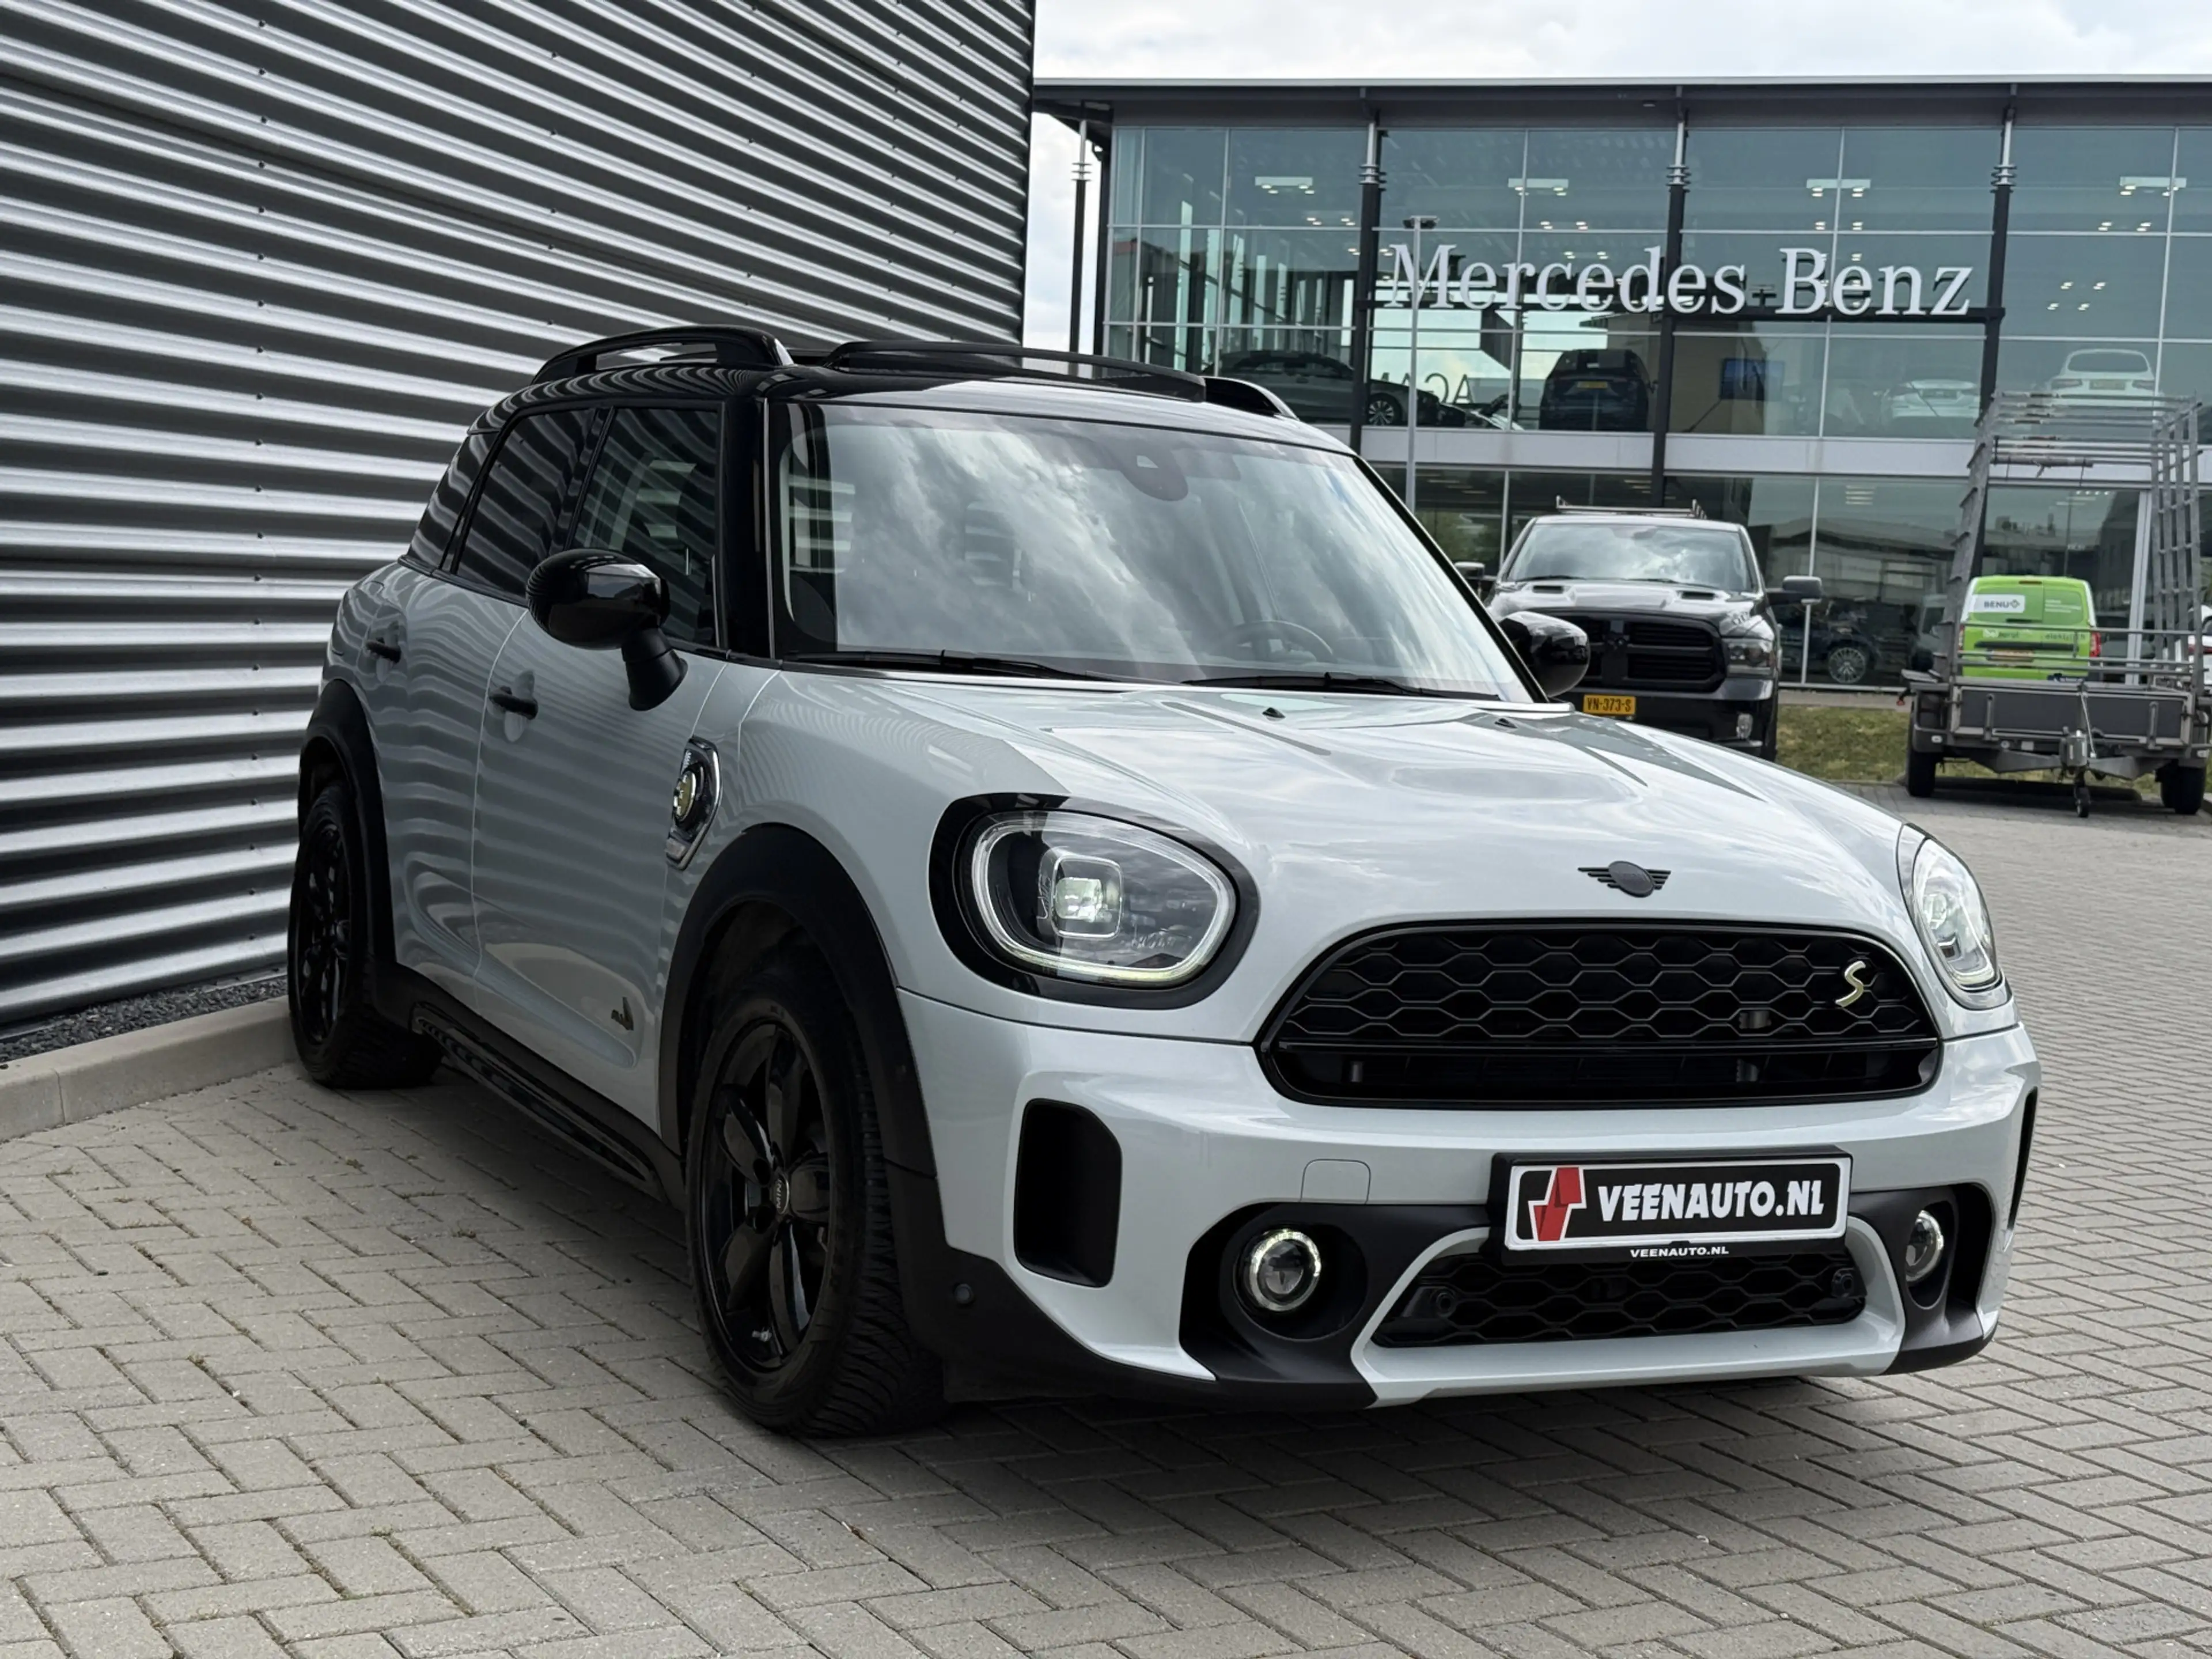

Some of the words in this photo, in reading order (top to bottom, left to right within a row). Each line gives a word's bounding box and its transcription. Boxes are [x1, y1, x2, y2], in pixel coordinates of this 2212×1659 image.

[1384, 244, 1746, 315] Mercedes
[1775, 247, 1973, 316] Benz
[1984, 601, 2009, 609] BENU
[1587, 698, 1631, 711] VN-373-S
[1835, 960, 1866, 1007] S
[1597, 1180, 1824, 1222] VEENAUTO.NL
[1630, 1247, 1729, 1258] VEENAUTO.NL
